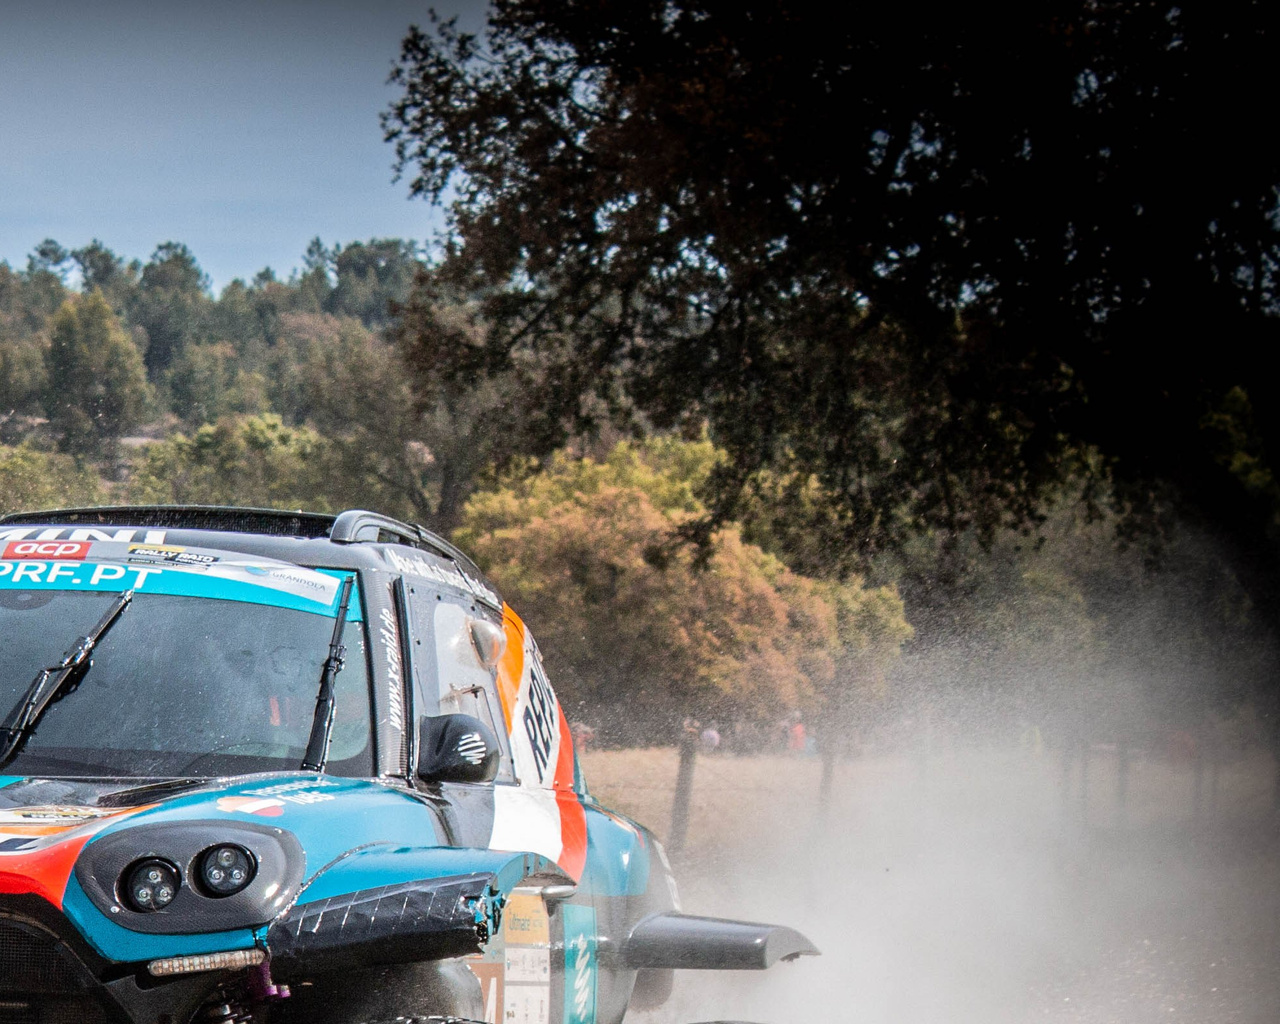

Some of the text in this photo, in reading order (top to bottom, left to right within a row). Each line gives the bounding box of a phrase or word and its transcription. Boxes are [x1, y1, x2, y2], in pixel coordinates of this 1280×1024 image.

[13, 542, 76, 557] acp
[134, 549, 215, 562] RALLY RAID
[380, 607, 402, 731] www.x-raid.de
